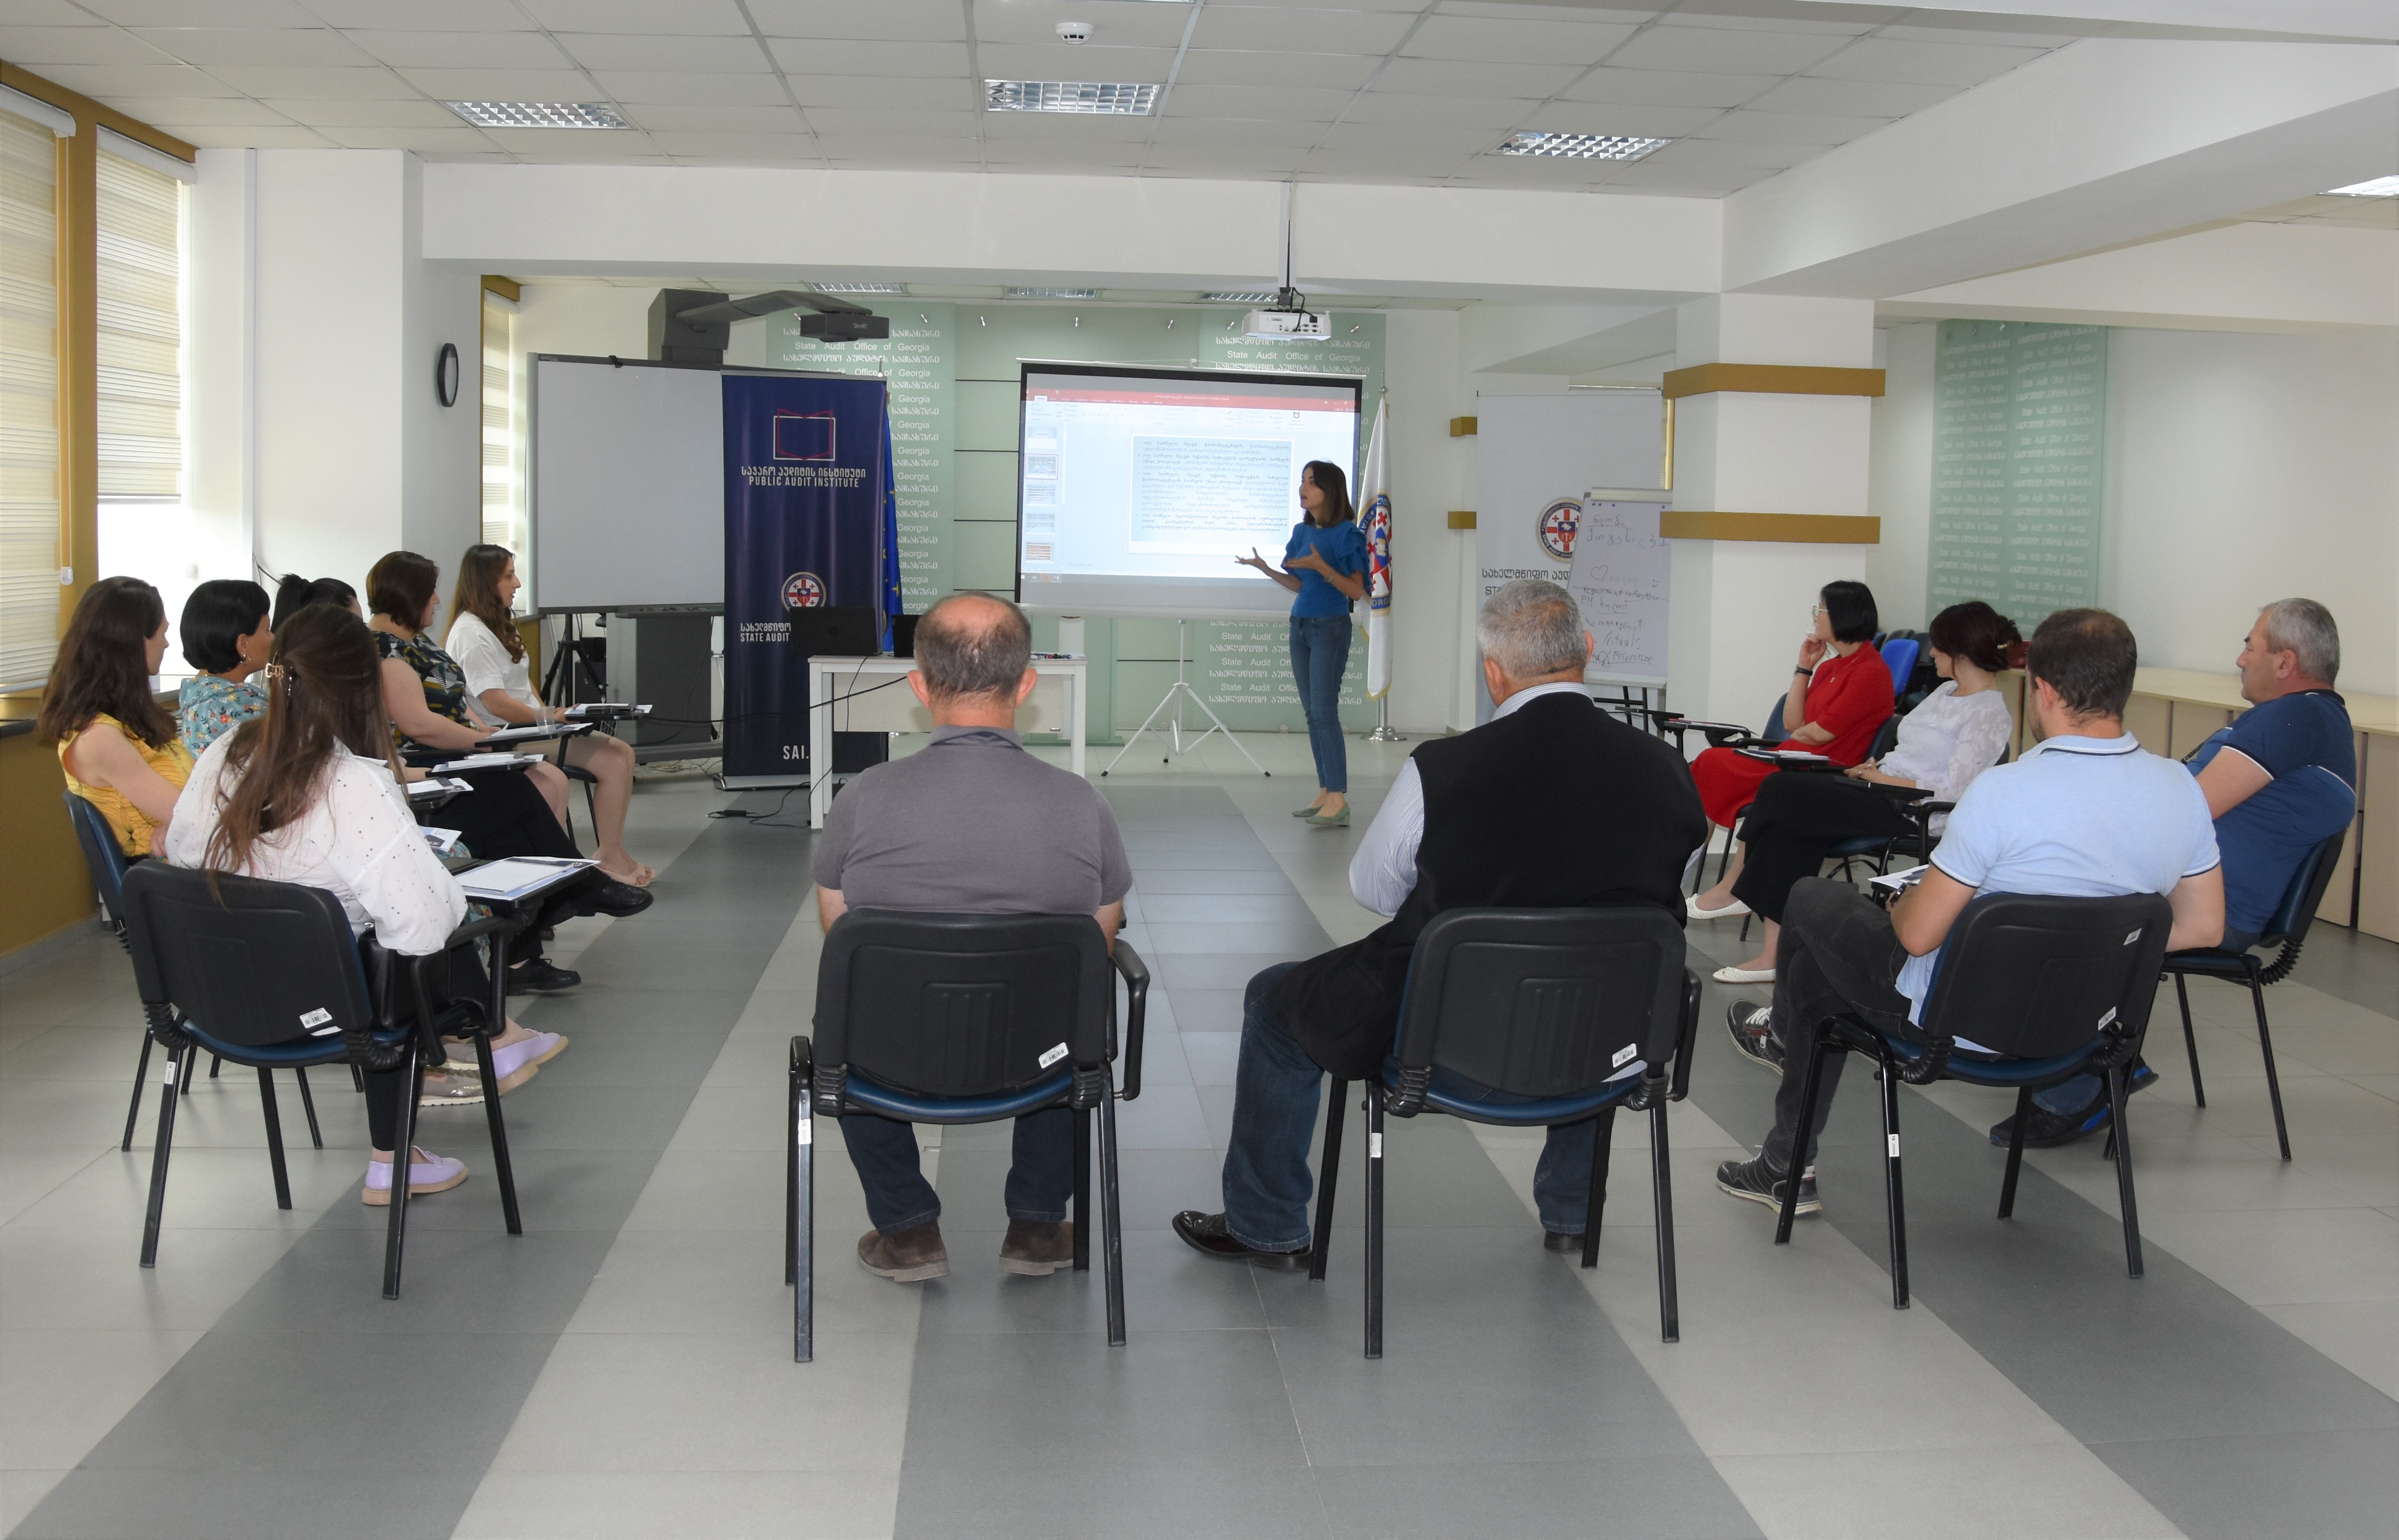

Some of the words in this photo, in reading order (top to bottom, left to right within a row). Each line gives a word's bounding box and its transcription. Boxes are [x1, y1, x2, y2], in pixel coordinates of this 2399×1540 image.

[898, 343, 929, 352] Georgia
[1329, 353, 1360, 363] Georgia
[899, 369, 930, 378] Georgia
[899, 395, 930, 404] Georgia
[898, 421, 929, 430] Georgia
[898, 446, 929, 456] Georgia
[742, 466, 776, 475] საჯარო
[778, 467, 816, 477] აუდიტის
[818, 467, 866, 478] ინსტიტუტი
[898, 472, 929, 481] Georgia
[749, 476, 781, 486] PUBLIC
[785, 477, 811, 487] AUDIT
[815, 477, 859, 488] INSTITUTE
[898, 498, 929, 507] Georgia
[897, 524, 928, 533] Georgia
[898, 549, 928, 559] Georgia
[1482, 568, 1548, 579] სახელმწიფო
[903, 602, 928, 611] eorgia
[741, 633, 763, 642] STATE
[766, 633, 790, 642] AUDIT
